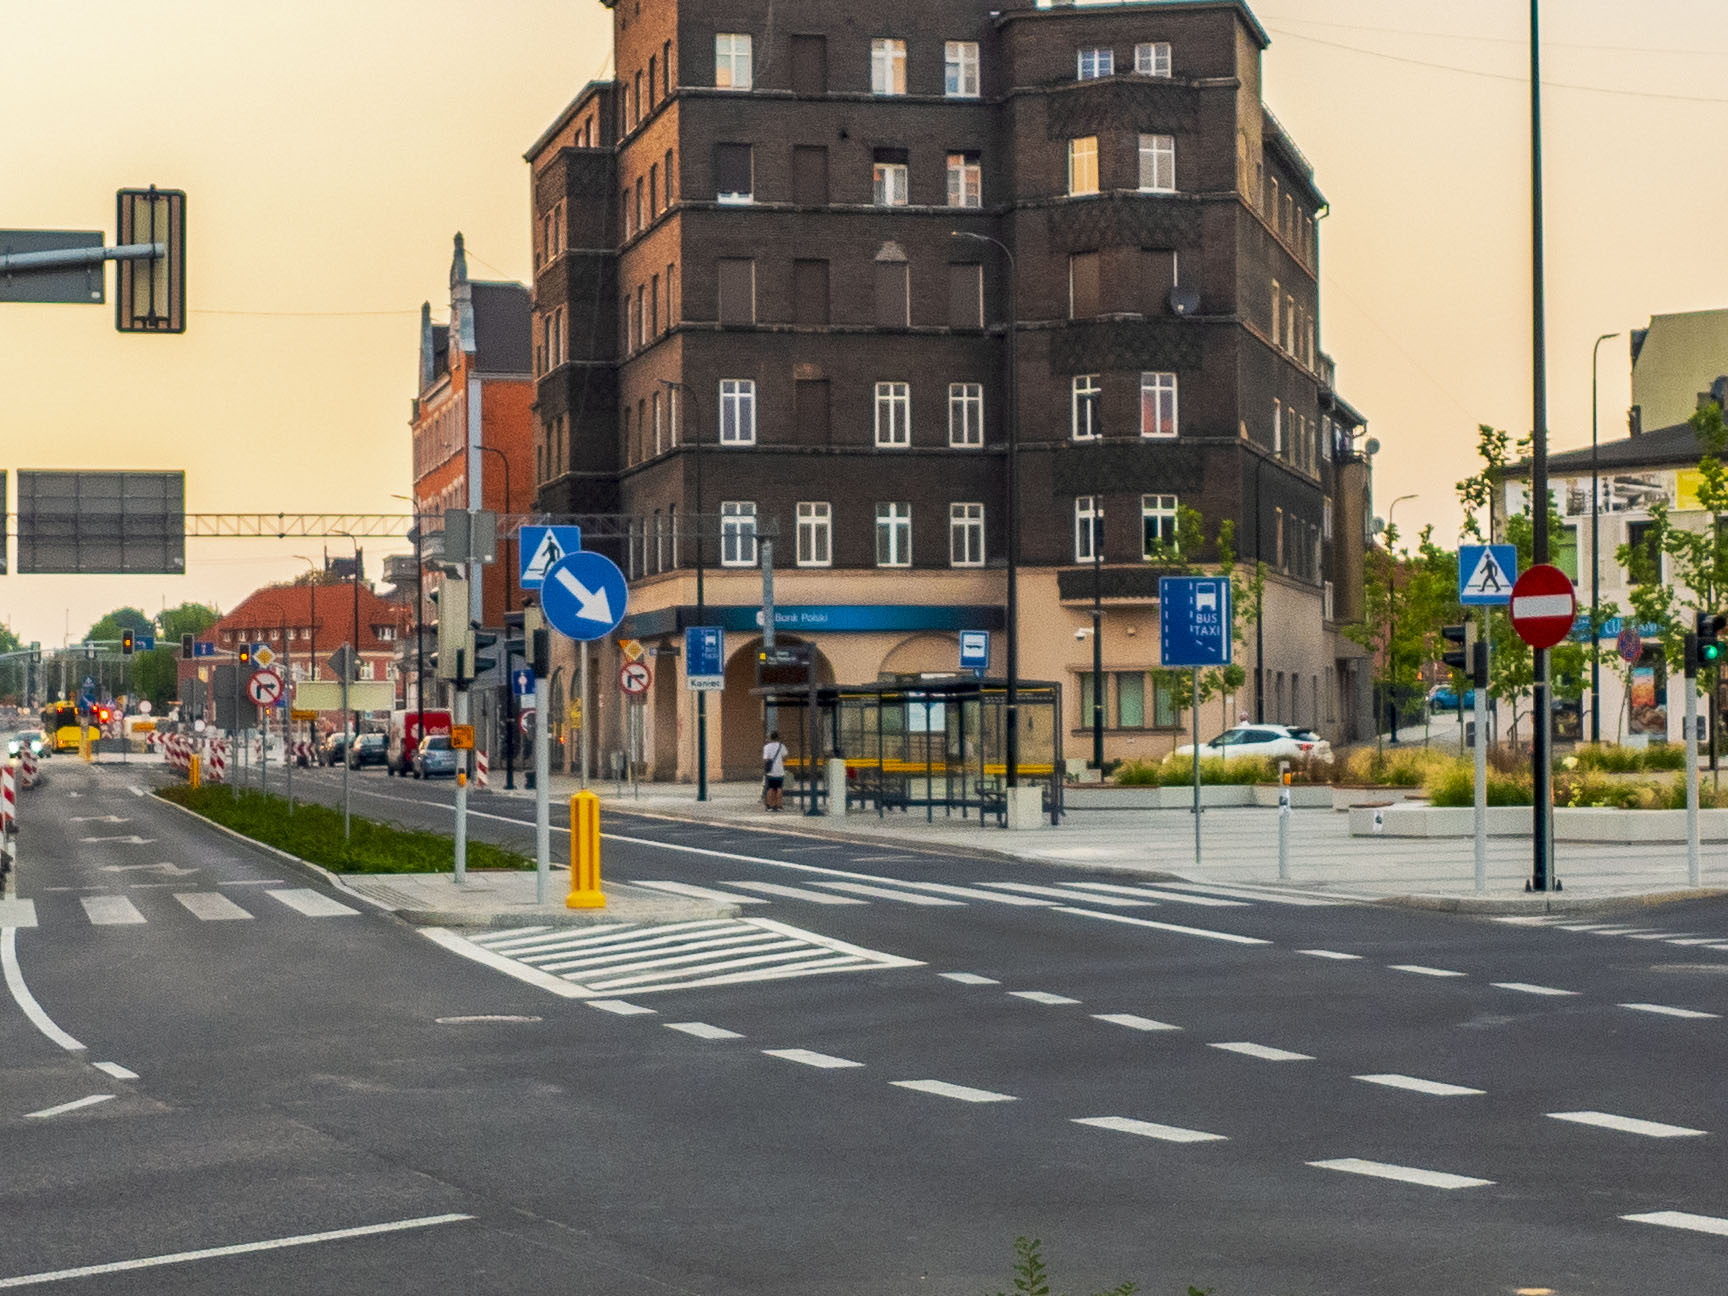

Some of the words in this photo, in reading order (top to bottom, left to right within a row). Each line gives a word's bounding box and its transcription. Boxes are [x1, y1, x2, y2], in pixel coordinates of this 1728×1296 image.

[775, 613, 798, 622] Bank
[801, 613, 828, 622] Polski
[1196, 613, 1217, 624] BUS
[1194, 625, 1221, 636] TAXI
